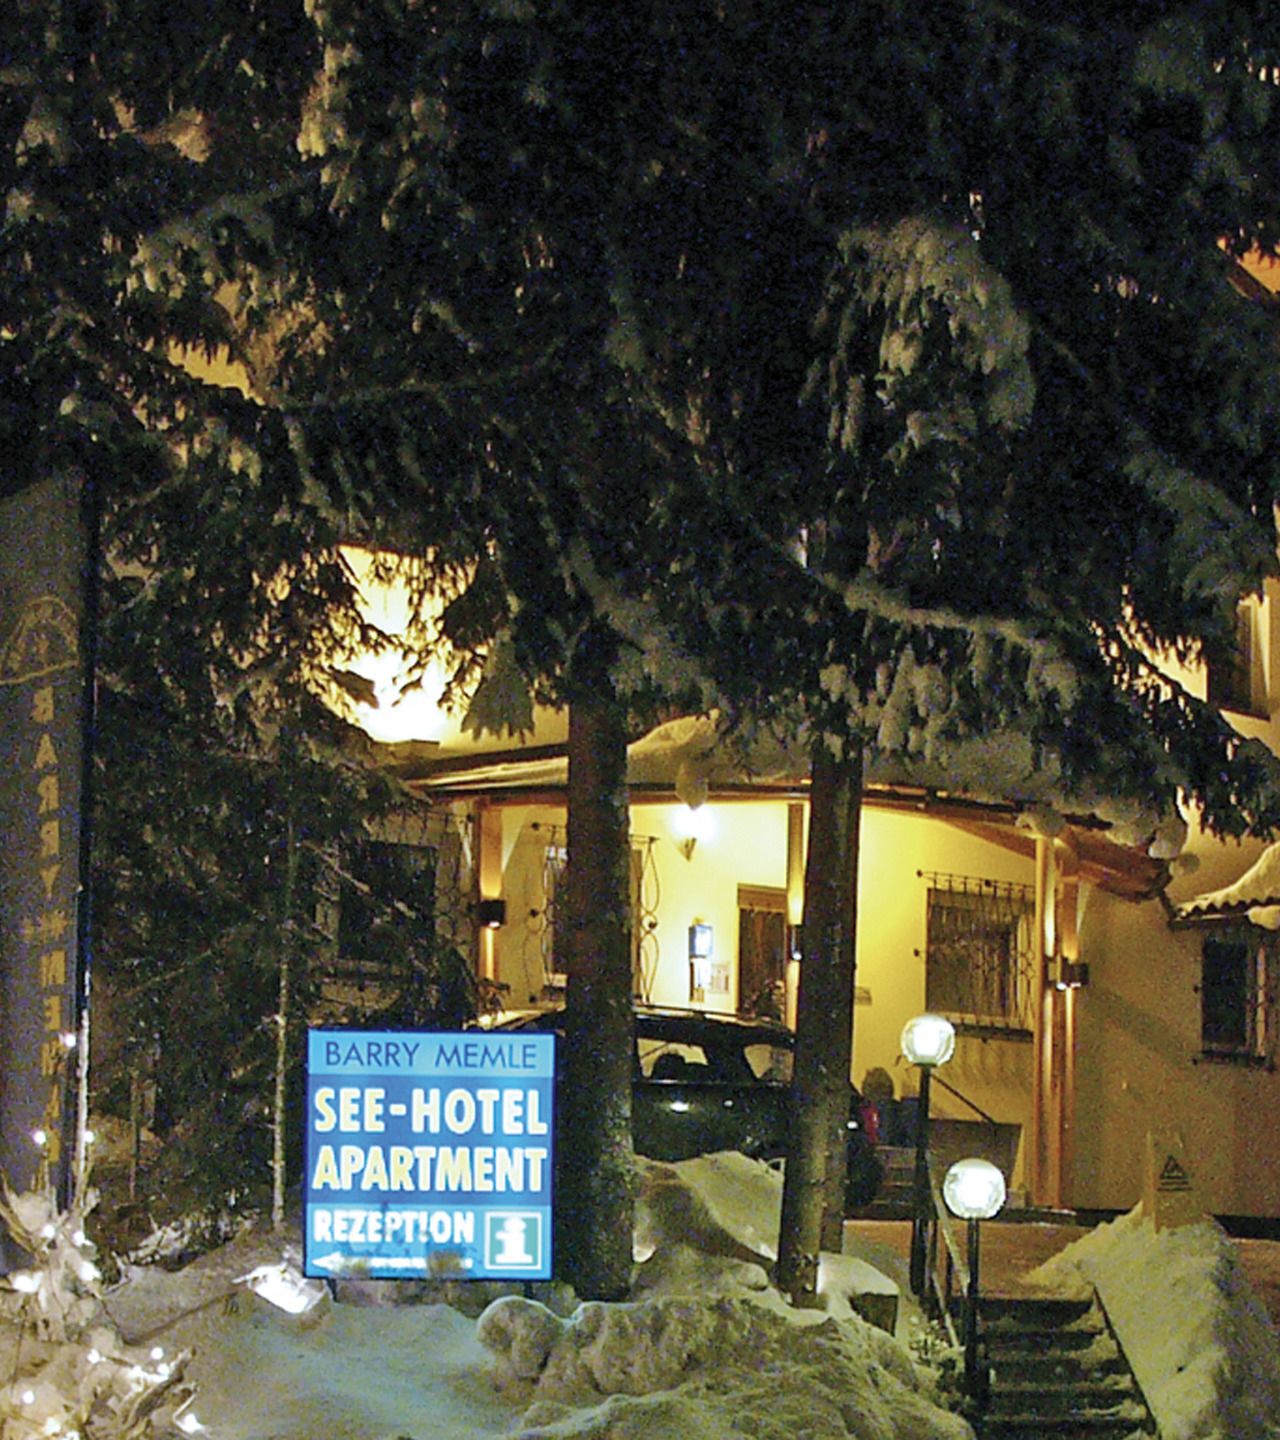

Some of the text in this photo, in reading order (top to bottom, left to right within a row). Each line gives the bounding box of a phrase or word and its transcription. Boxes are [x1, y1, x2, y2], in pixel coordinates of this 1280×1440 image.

[325, 1041, 537, 1070] BARRY MEMLE
[314, 1087, 547, 1134] SEE-HOTEL
[312, 1146, 547, 1191] APARTMENT
[314, 1210, 473, 1243] REZEPTION
